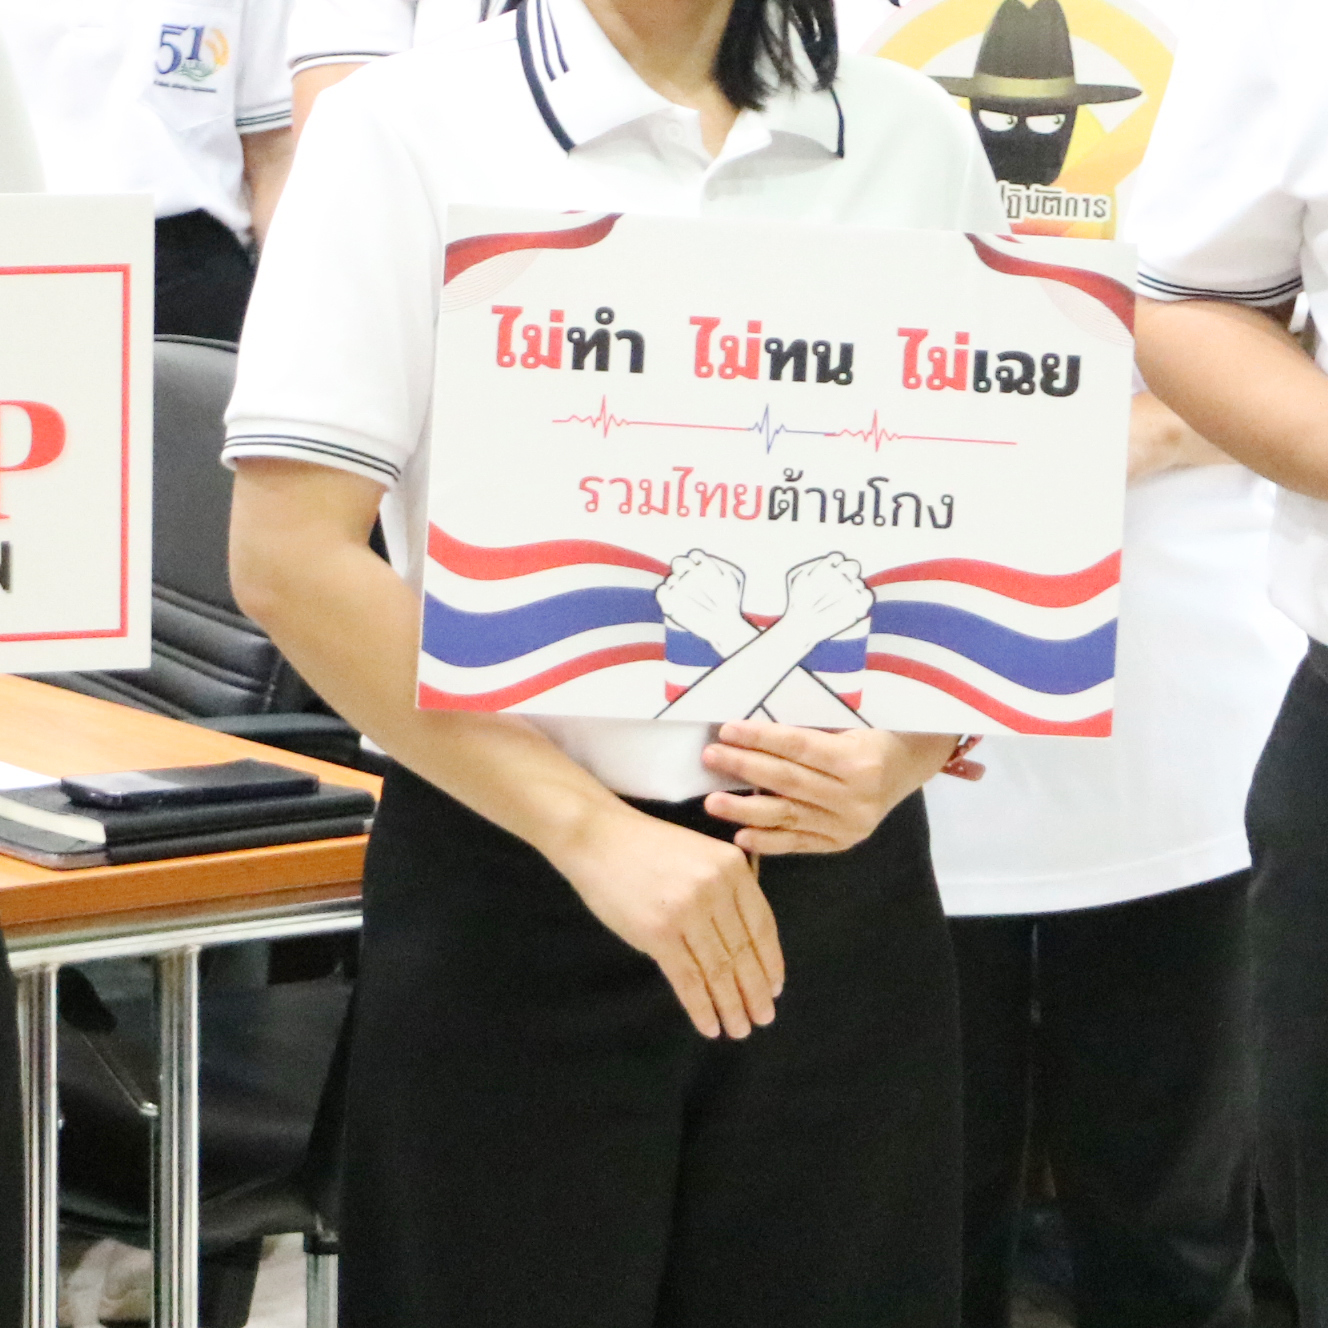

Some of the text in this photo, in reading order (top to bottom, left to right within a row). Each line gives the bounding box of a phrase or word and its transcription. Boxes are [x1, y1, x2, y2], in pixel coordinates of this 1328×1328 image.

[154, 24, 205, 75] 51
[491, 305, 1081, 398] ไม่ทำ ไม่ทน ไม่เฉย
[577, 466, 955, 531] รวมไทยต้านโกง
